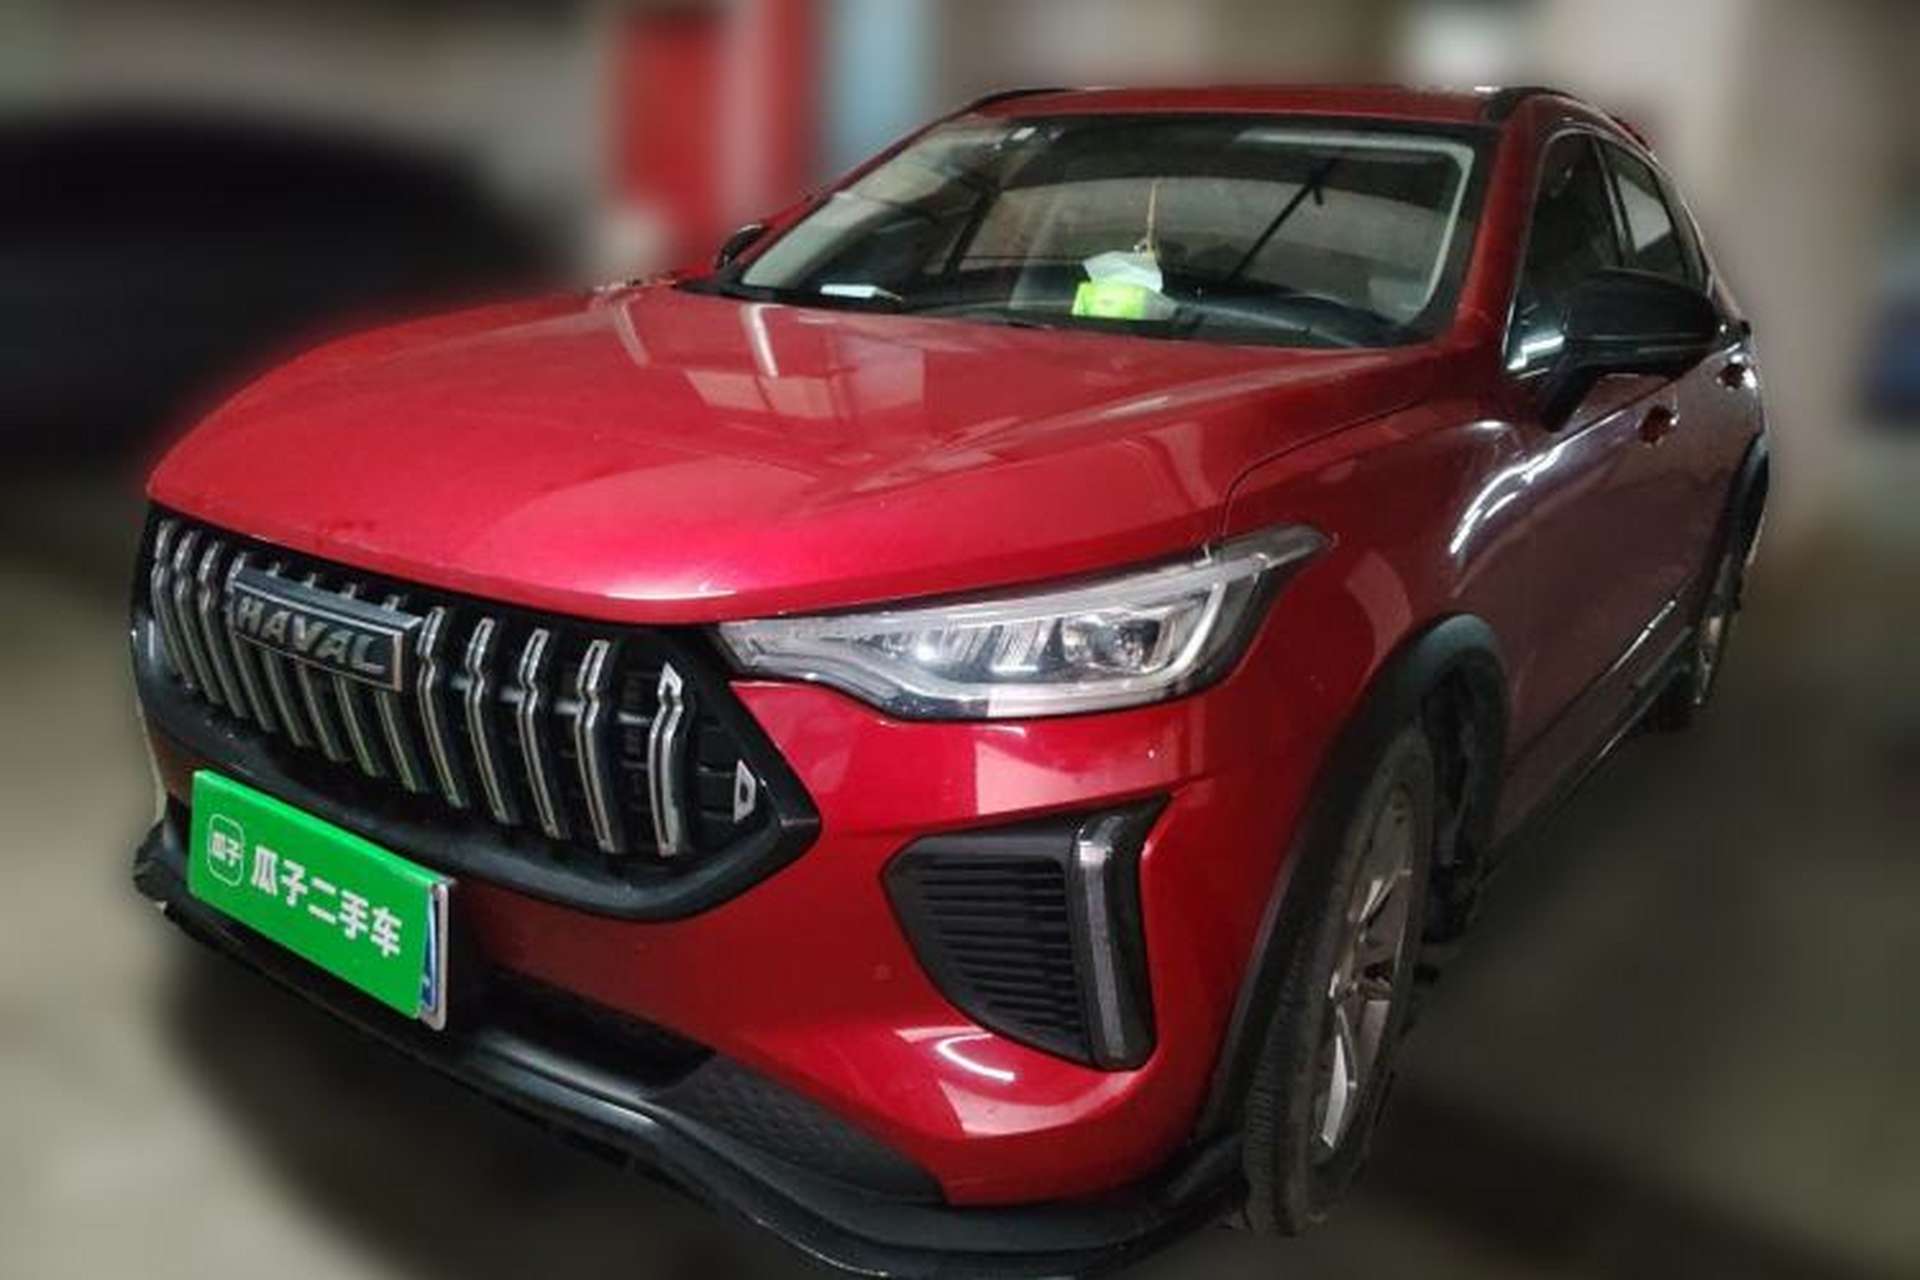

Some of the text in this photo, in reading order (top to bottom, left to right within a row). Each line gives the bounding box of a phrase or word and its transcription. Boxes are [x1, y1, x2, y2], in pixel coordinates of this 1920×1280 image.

[238, 596, 385, 674] HAVAL
[251, 845, 402, 958] 瓜子二手车
